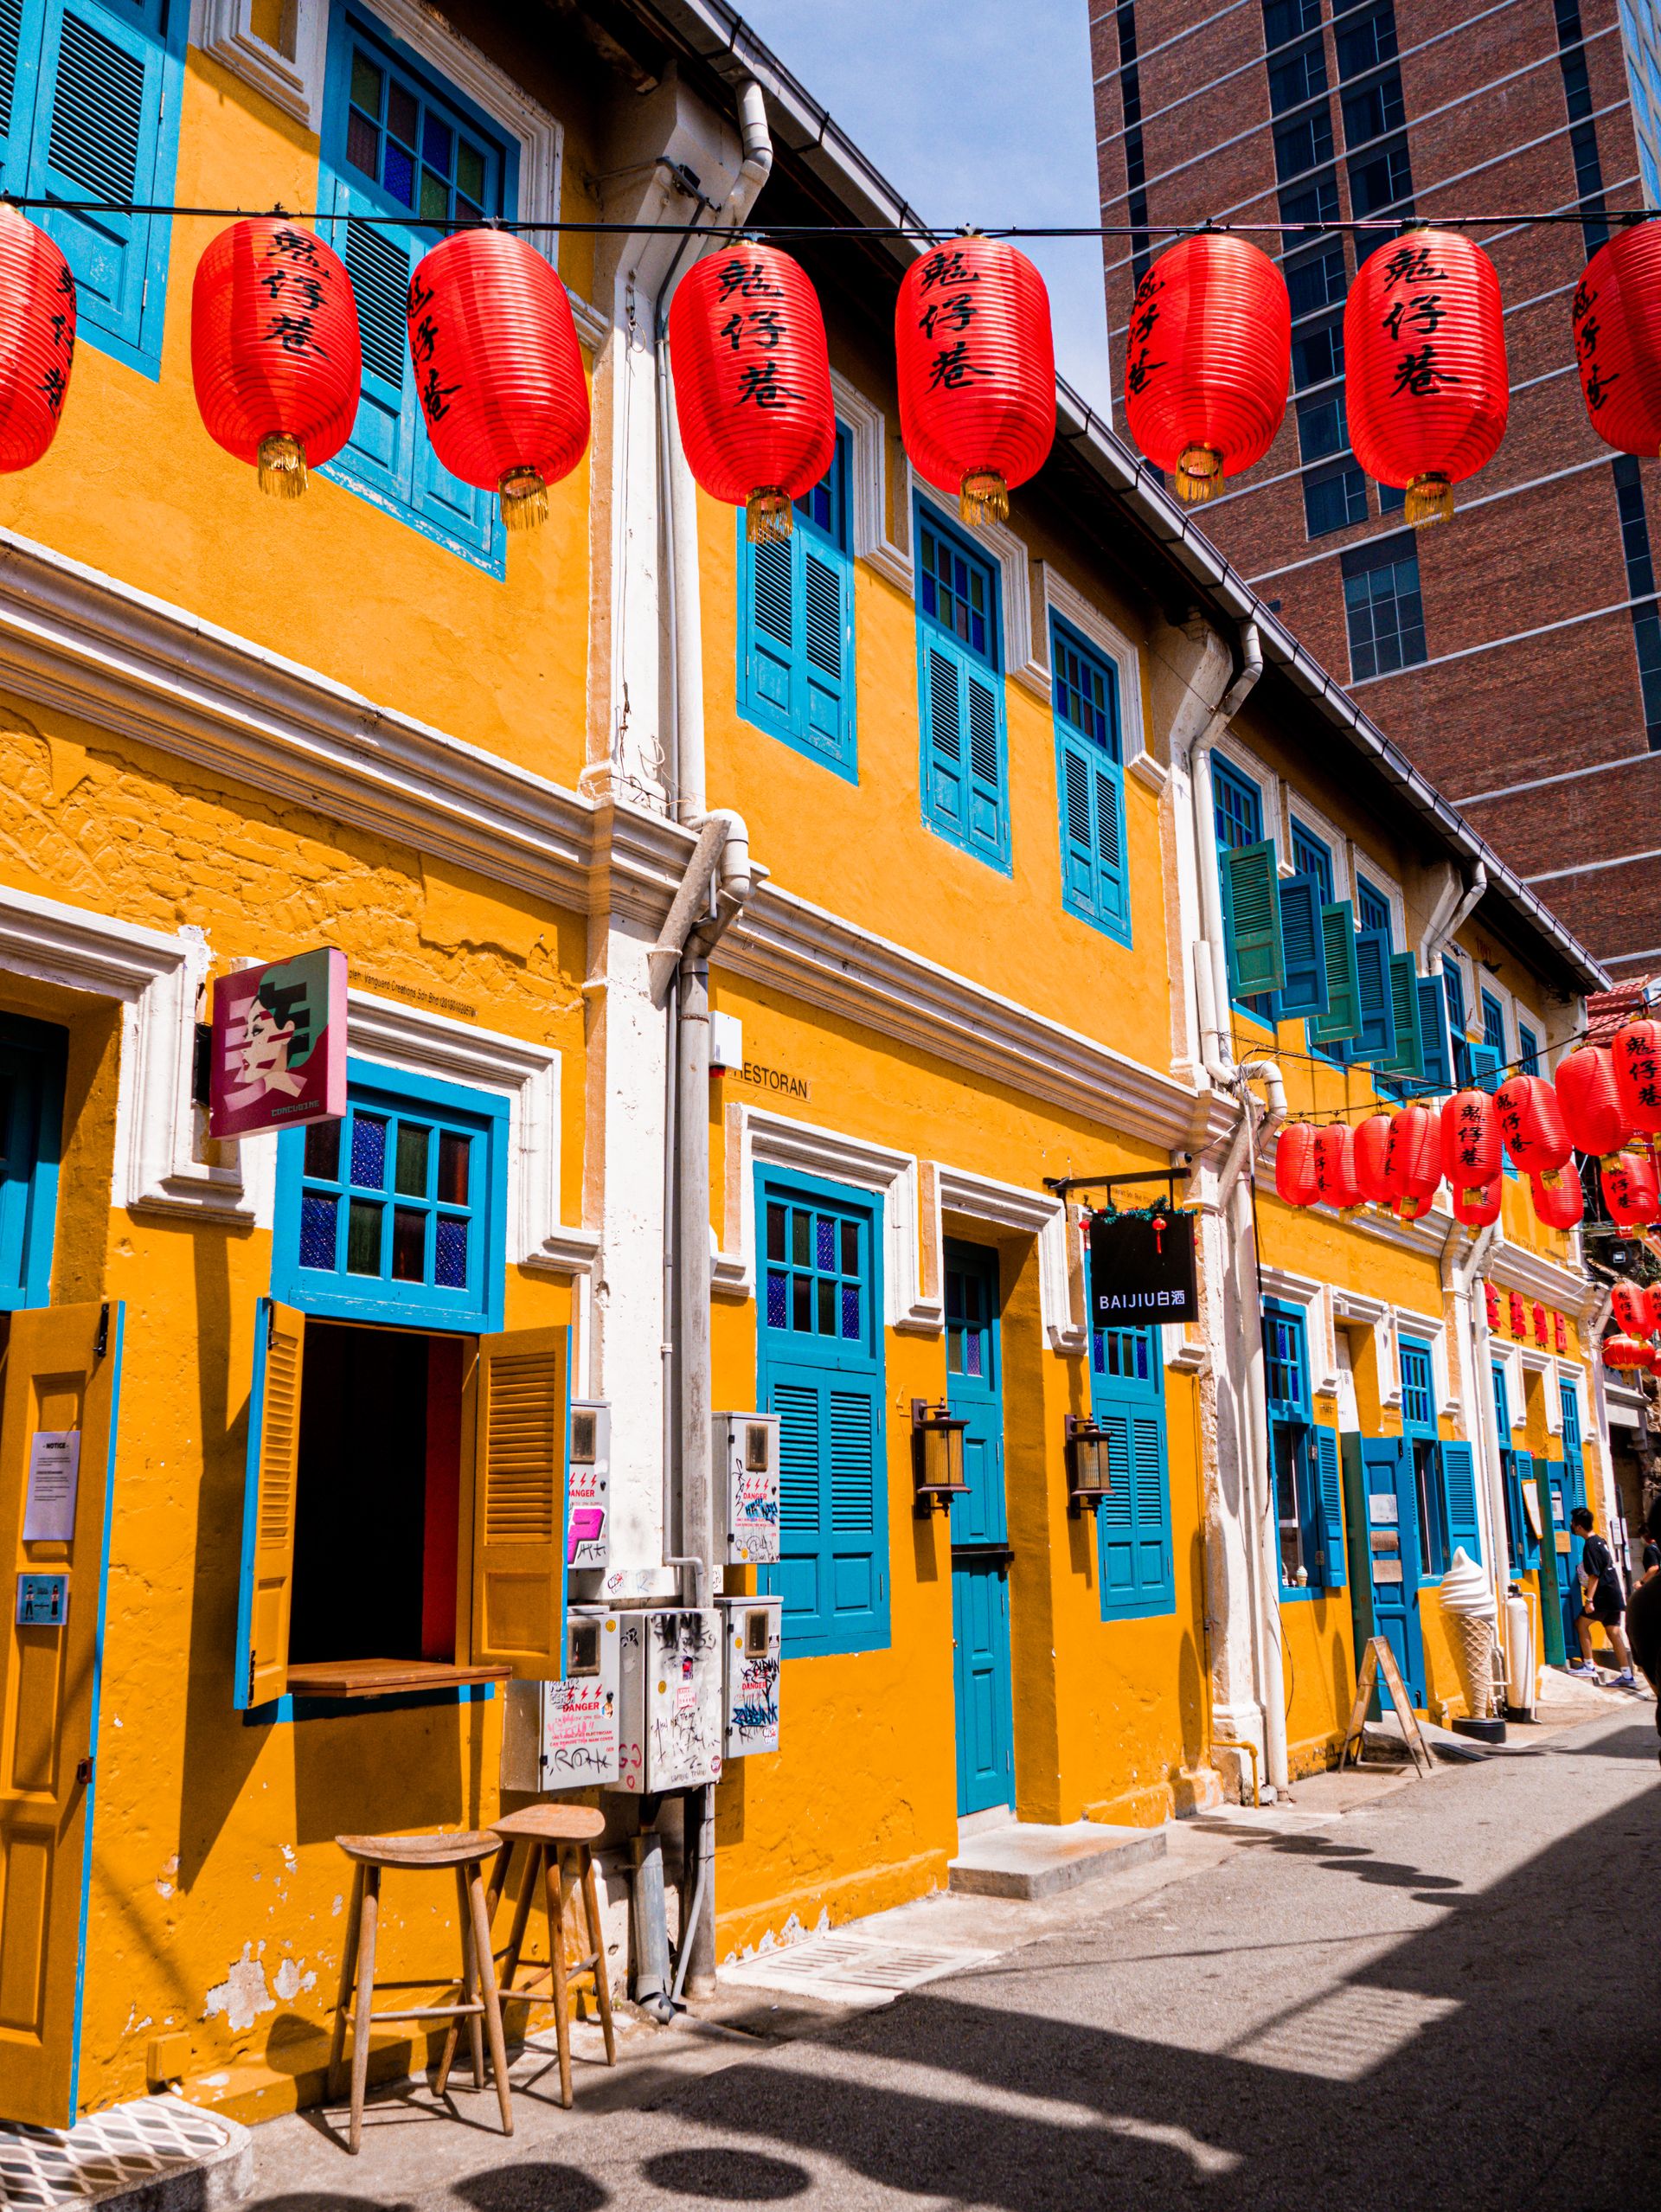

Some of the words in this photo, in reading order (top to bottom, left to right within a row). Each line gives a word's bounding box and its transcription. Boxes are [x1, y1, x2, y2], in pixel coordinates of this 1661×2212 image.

[717, 259, 806, 408] 鬼仔巷
[918, 251, 995, 394] 鬼仔巷
[1382, 247, 1460, 398] 鬼仔巷
[568, 1489, 595, 1497] ANGER
[562, 1702, 600, 1713] DANGER
